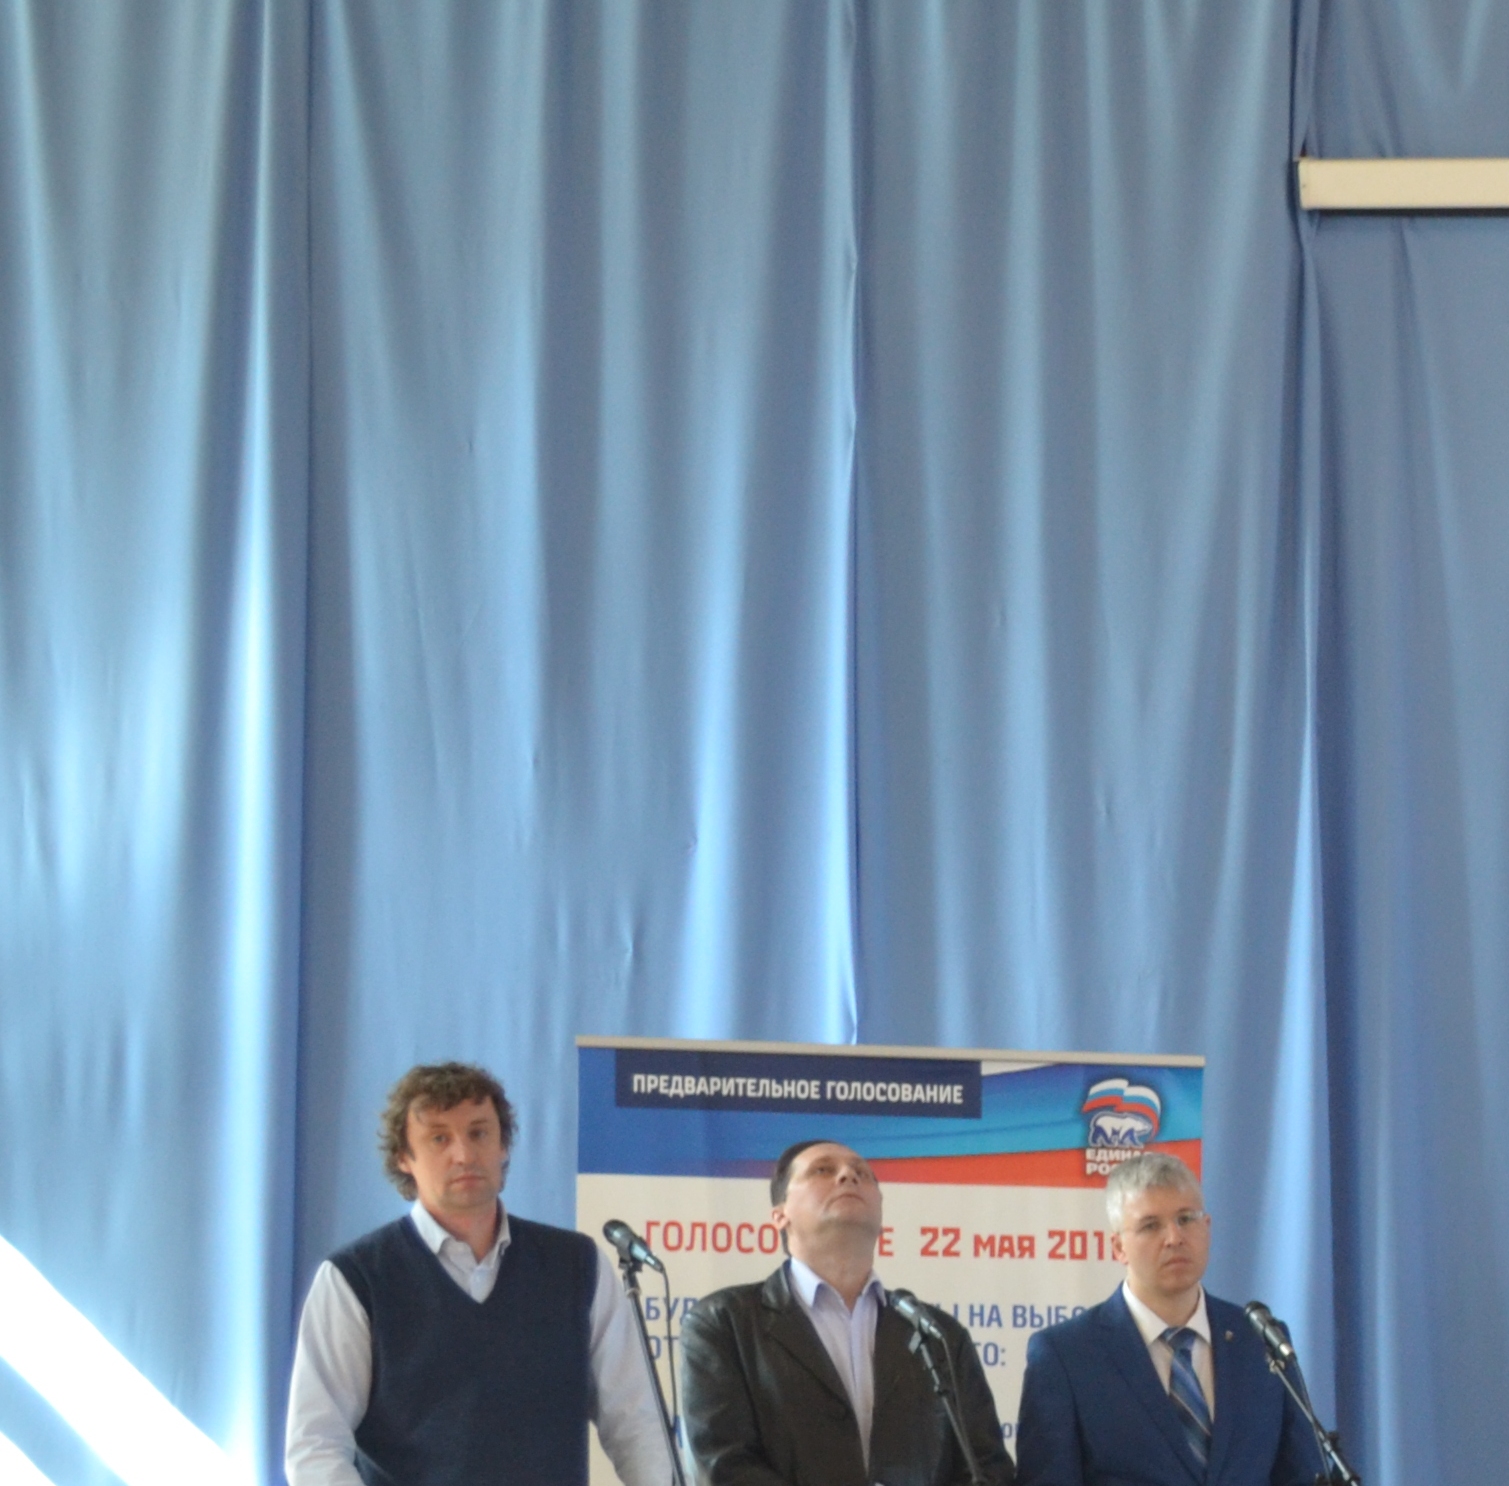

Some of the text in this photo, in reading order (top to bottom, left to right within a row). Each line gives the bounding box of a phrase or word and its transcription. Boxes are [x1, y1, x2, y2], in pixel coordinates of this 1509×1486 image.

[632, 1074, 964, 1104] ПРЕДВАРИТЕЛЬНОЕ ГОЛОСОВАНИЕ
[645, 1220, 894, 1257] ГОЛОСОЕ
[920, 1226, 961, 1258] 22
[1047, 1229, 1118, 1261] 201
[969, 1304, 1003, 1328] НА
